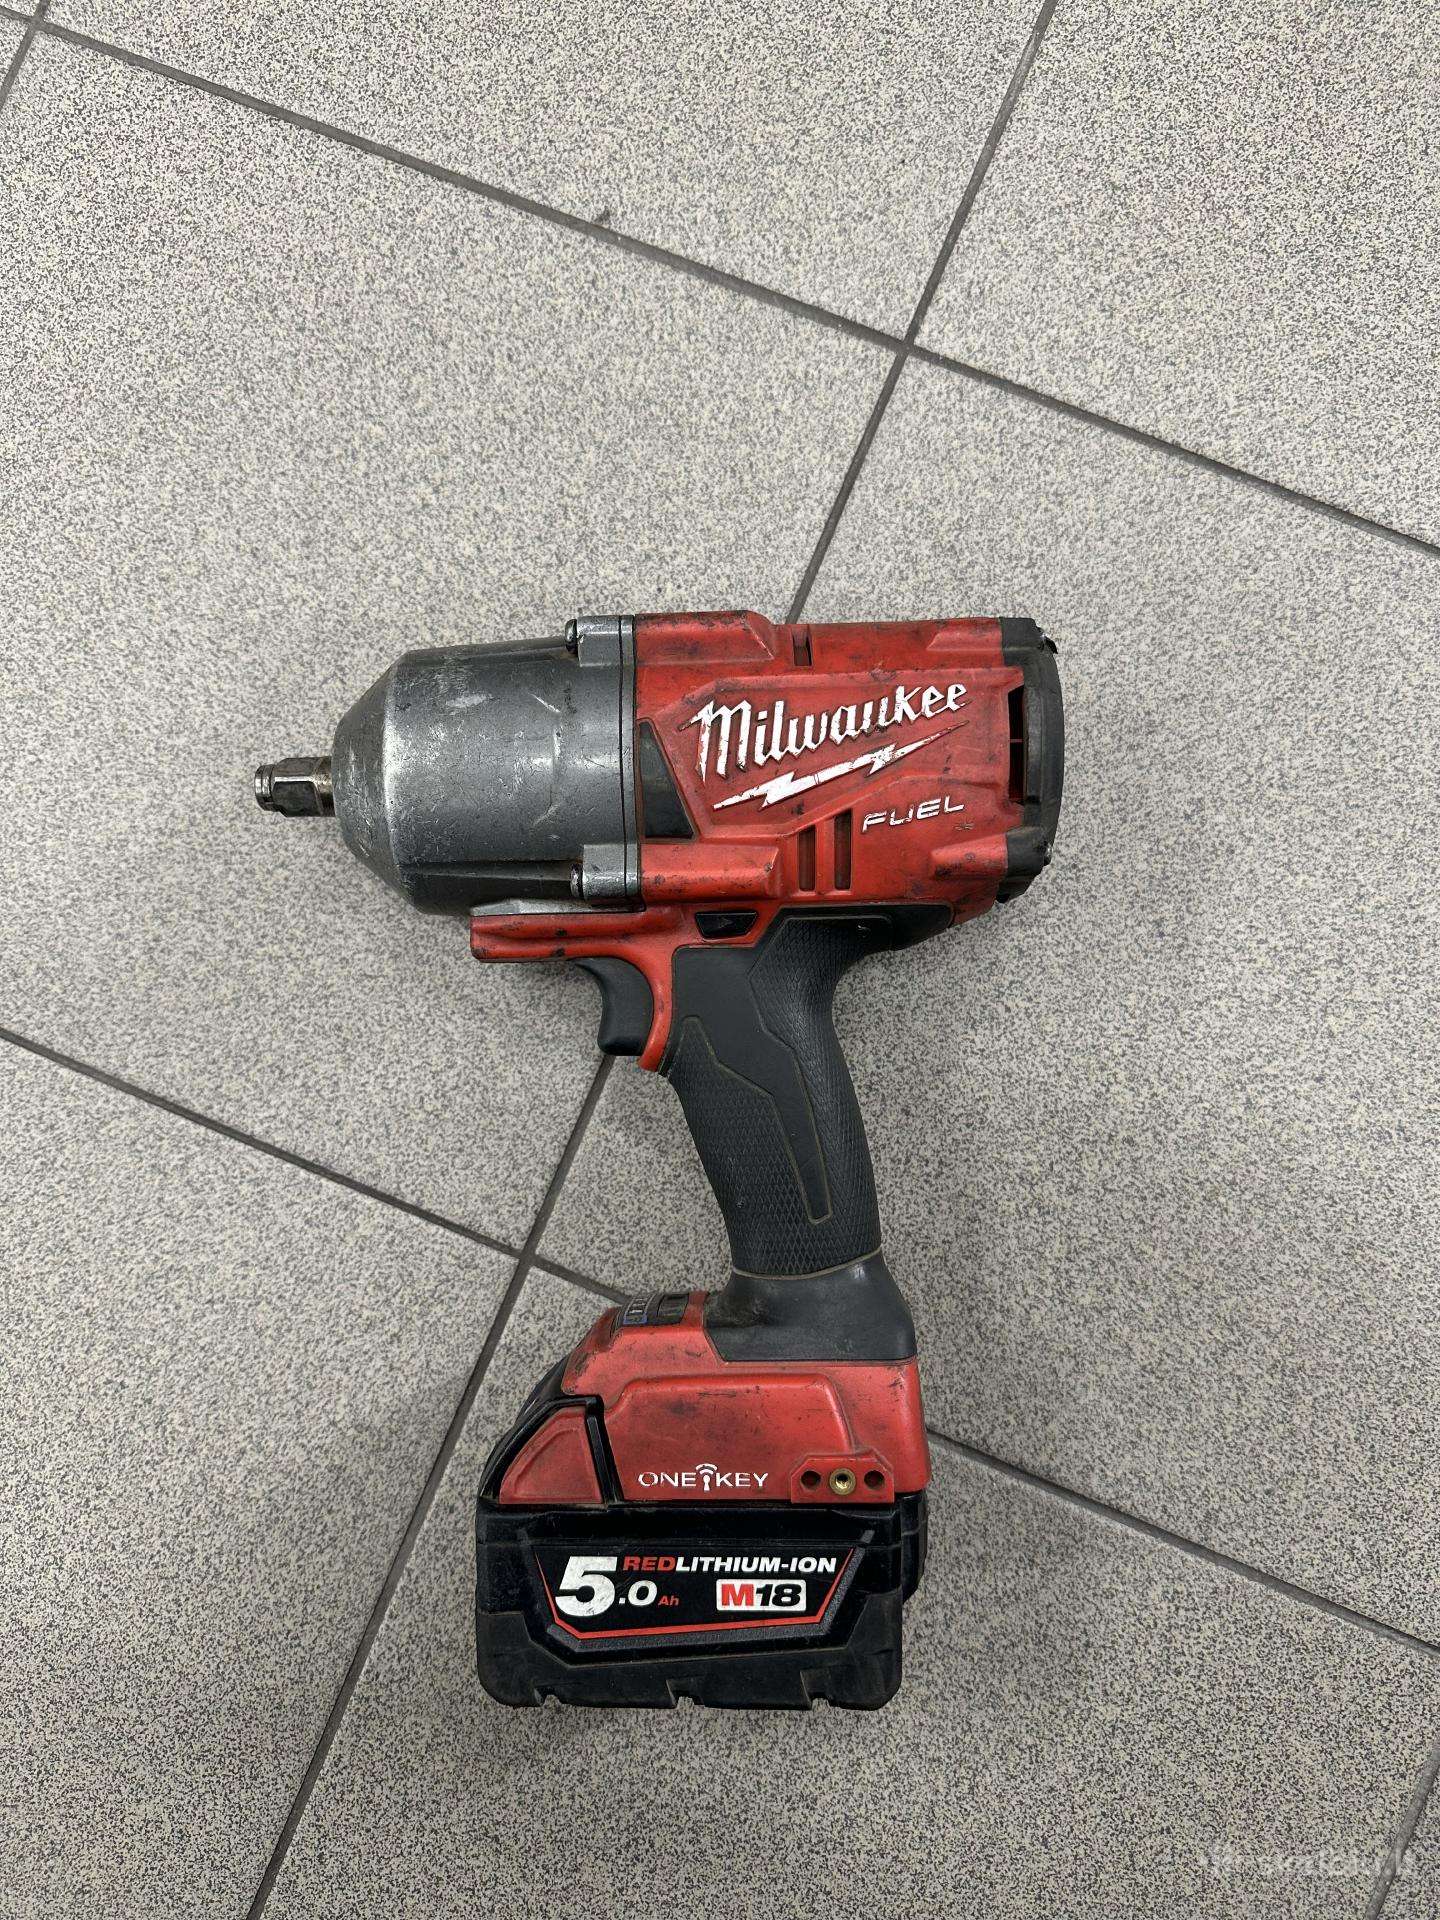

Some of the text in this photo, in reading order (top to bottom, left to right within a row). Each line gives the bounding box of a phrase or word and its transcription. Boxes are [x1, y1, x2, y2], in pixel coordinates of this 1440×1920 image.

[677, 683, 969, 783] Milwaukee
[862, 796, 965, 832] FUEL
[638, 1471, 769, 1488] ONE KEY
[622, 1556, 837, 1573] REDLITHIUM-ION
[555, 1556, 680, 1617] 5.0 Ah
[720, 1583, 803, 1608] M18
